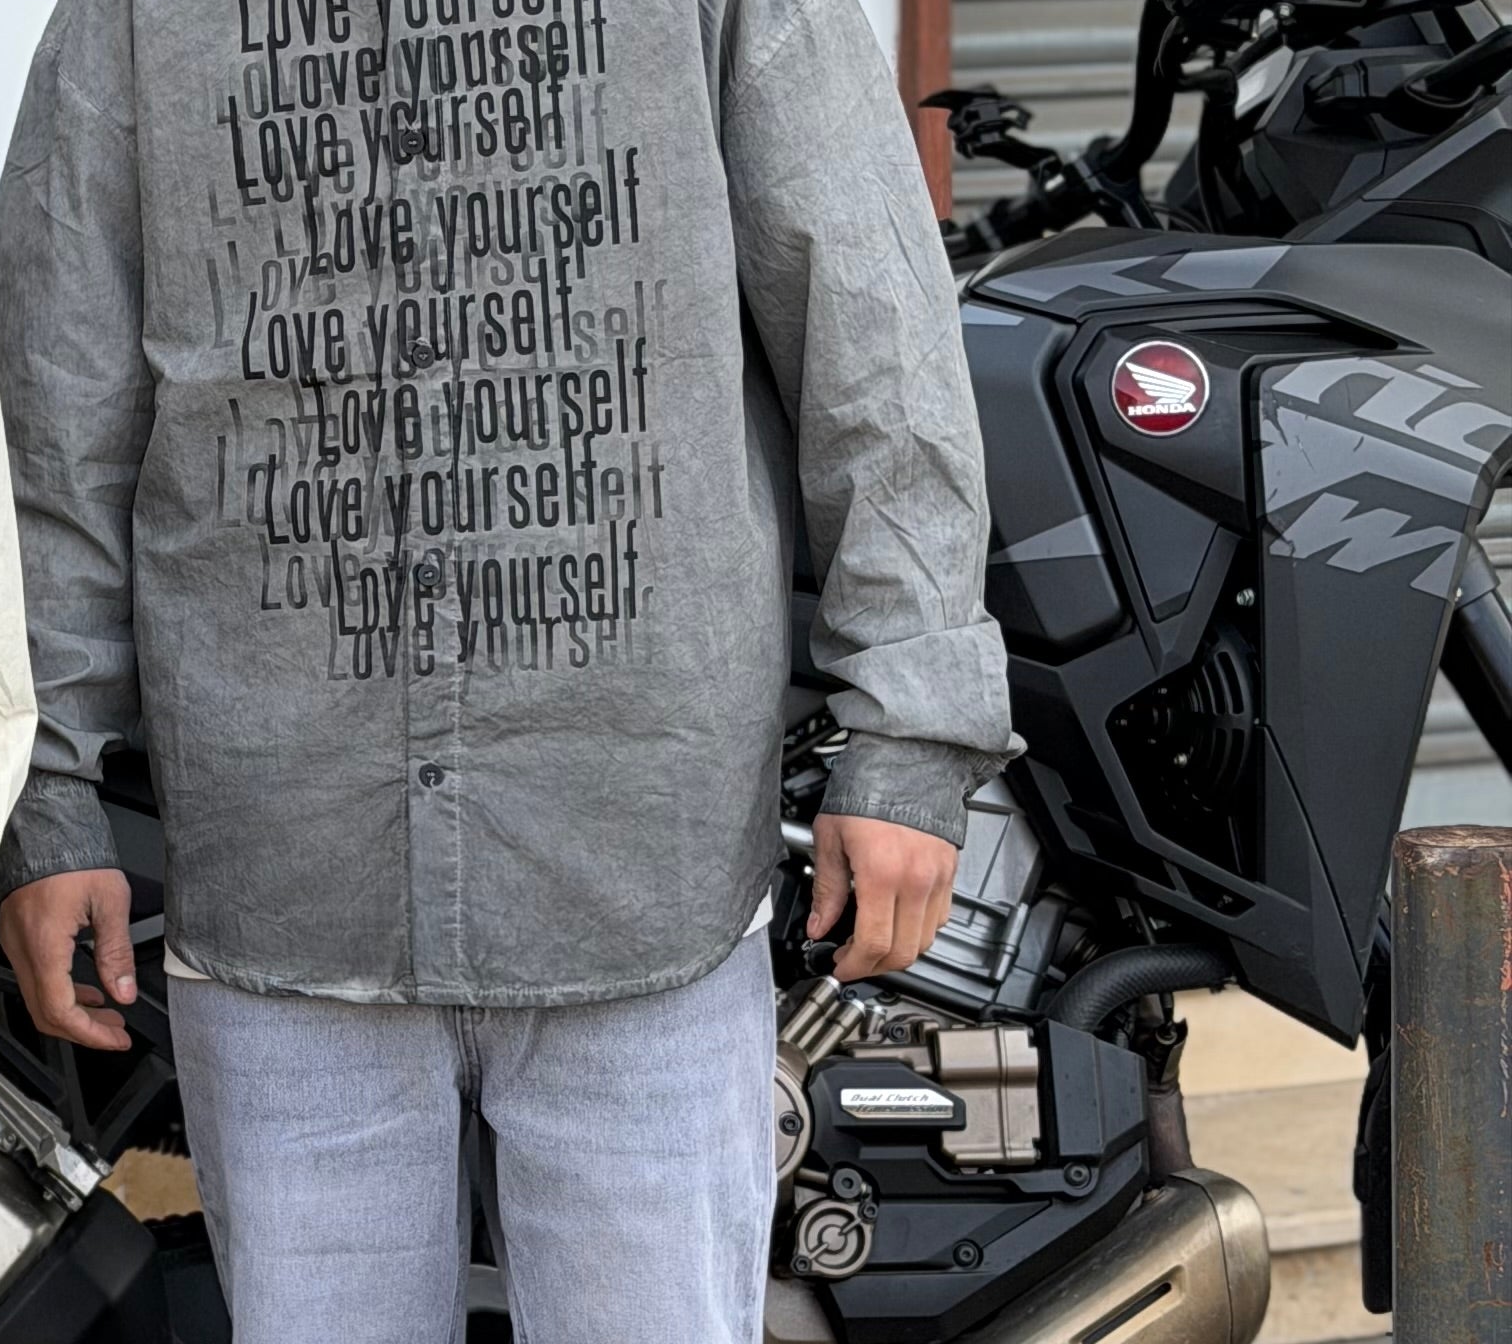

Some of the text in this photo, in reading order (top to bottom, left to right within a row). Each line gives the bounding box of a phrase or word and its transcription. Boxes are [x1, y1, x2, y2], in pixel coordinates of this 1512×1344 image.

[229, 96, 338, 189] Love
[360, 74, 564, 206] yourself
[267, 34, 381, 113] Love
[303, 185, 415, 276] Love
[435, 147, 640, 295] yourself
[241, 291, 346, 380] Love
[366, 256, 573, 400] yourself
[312, 337, 648, 480] Love yourself
[1128, 402, 1197, 416] HONDA
[265, 454, 363, 544] Love
[385, 430, 597, 571] yourself
[327, 586, 655, 702] Love yourself
[331, 519, 638, 663] Love yourself
[850, 1094, 930, 1102] Dual Clutch
